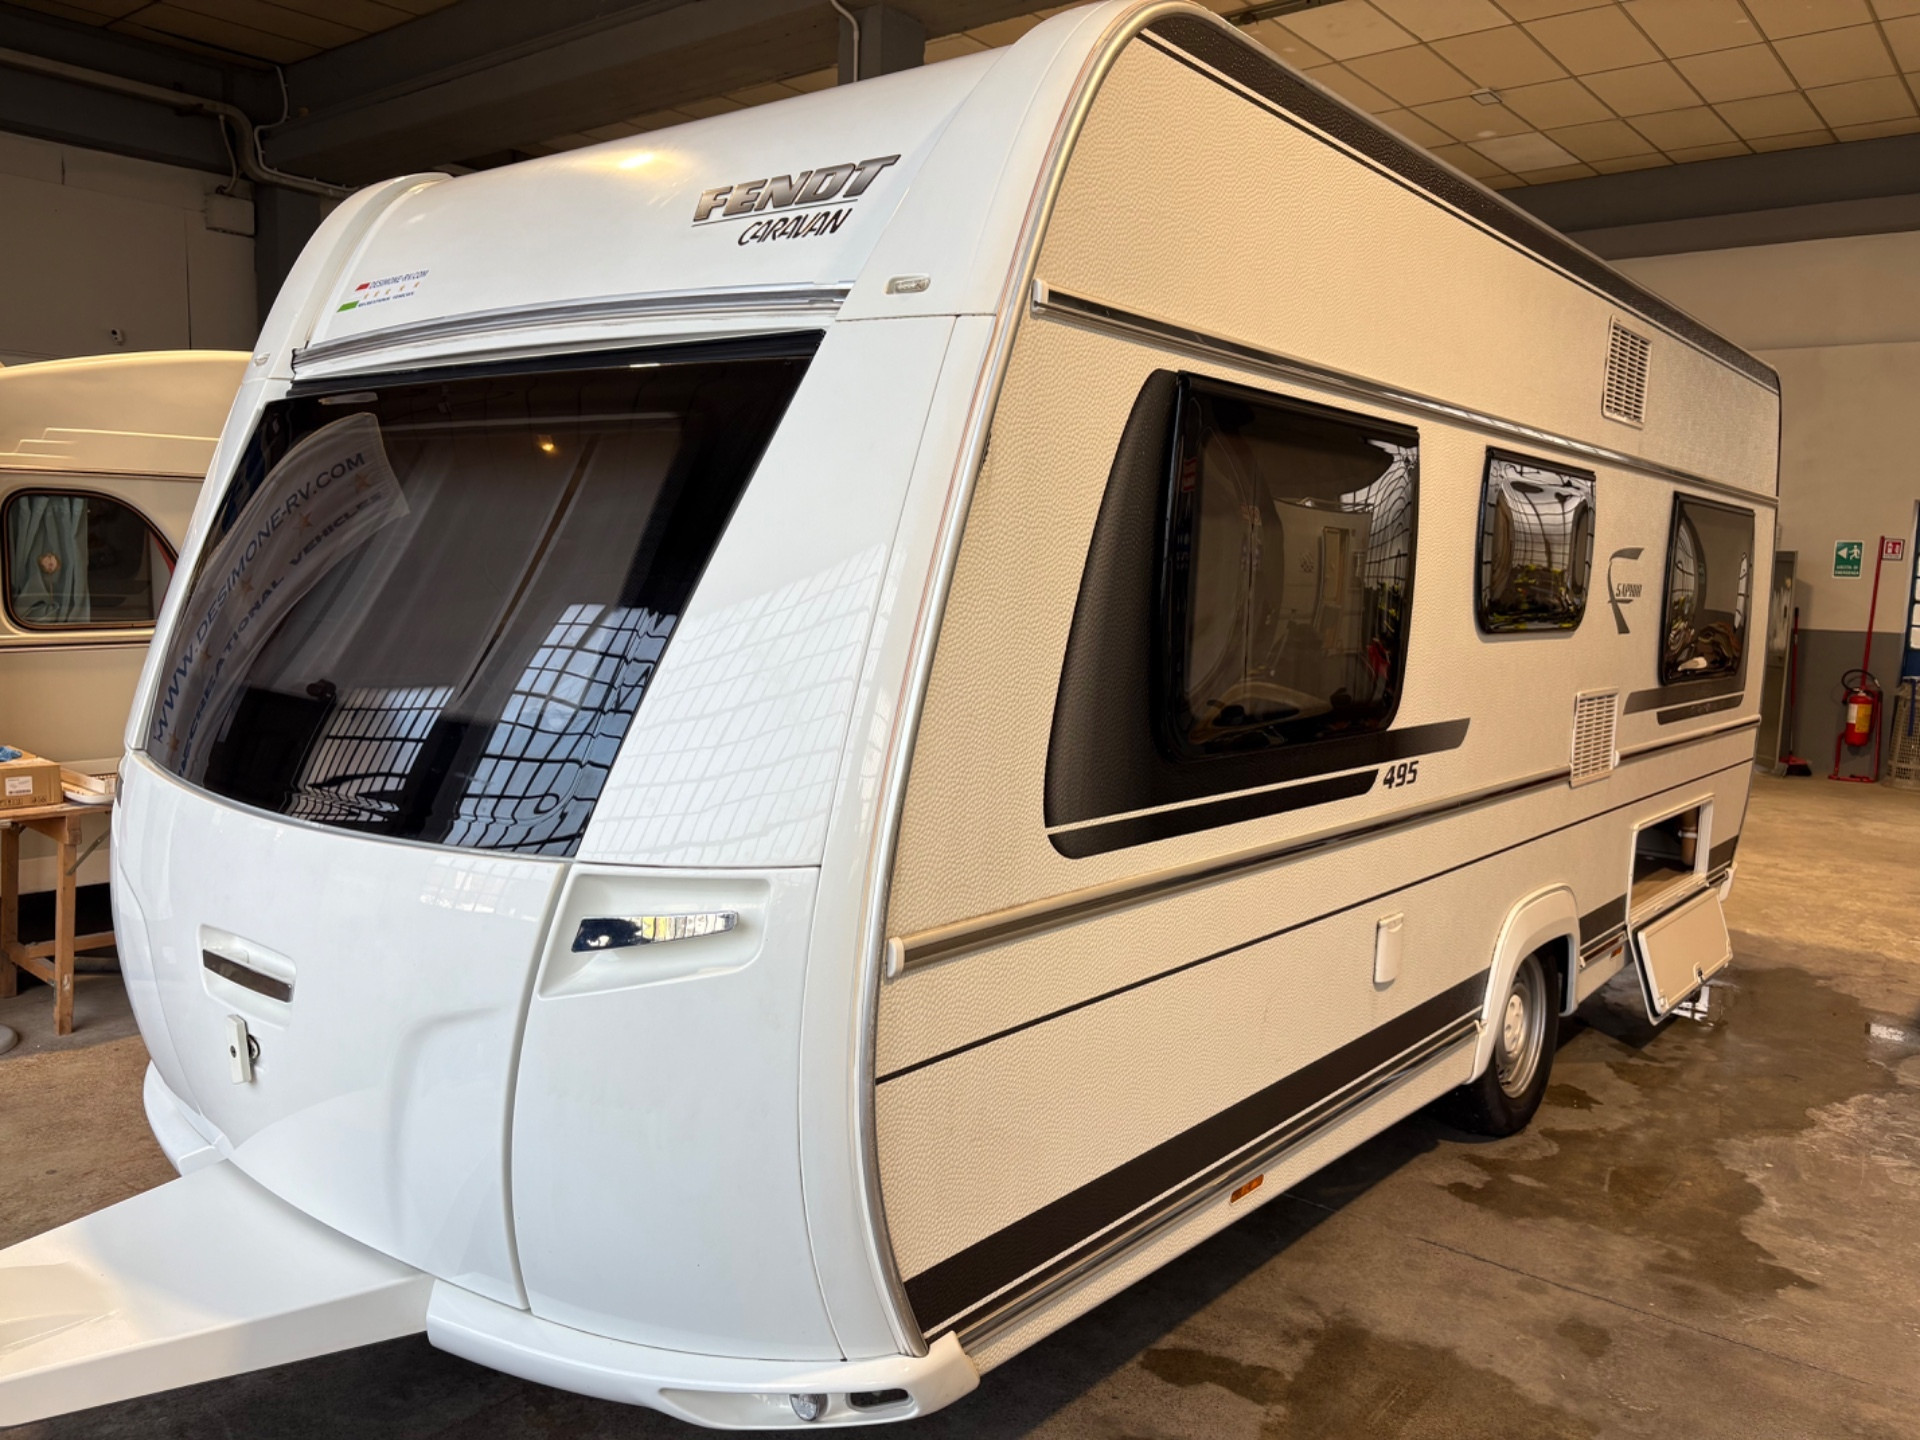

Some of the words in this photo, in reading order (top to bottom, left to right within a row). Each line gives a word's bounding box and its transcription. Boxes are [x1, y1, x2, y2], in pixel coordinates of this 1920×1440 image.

[693, 154, 901, 222] FENDT
[737, 208, 852, 246] CARAVAN
[289, 492, 383, 568] VEHICLES
[1383, 760, 1419, 789] 495
